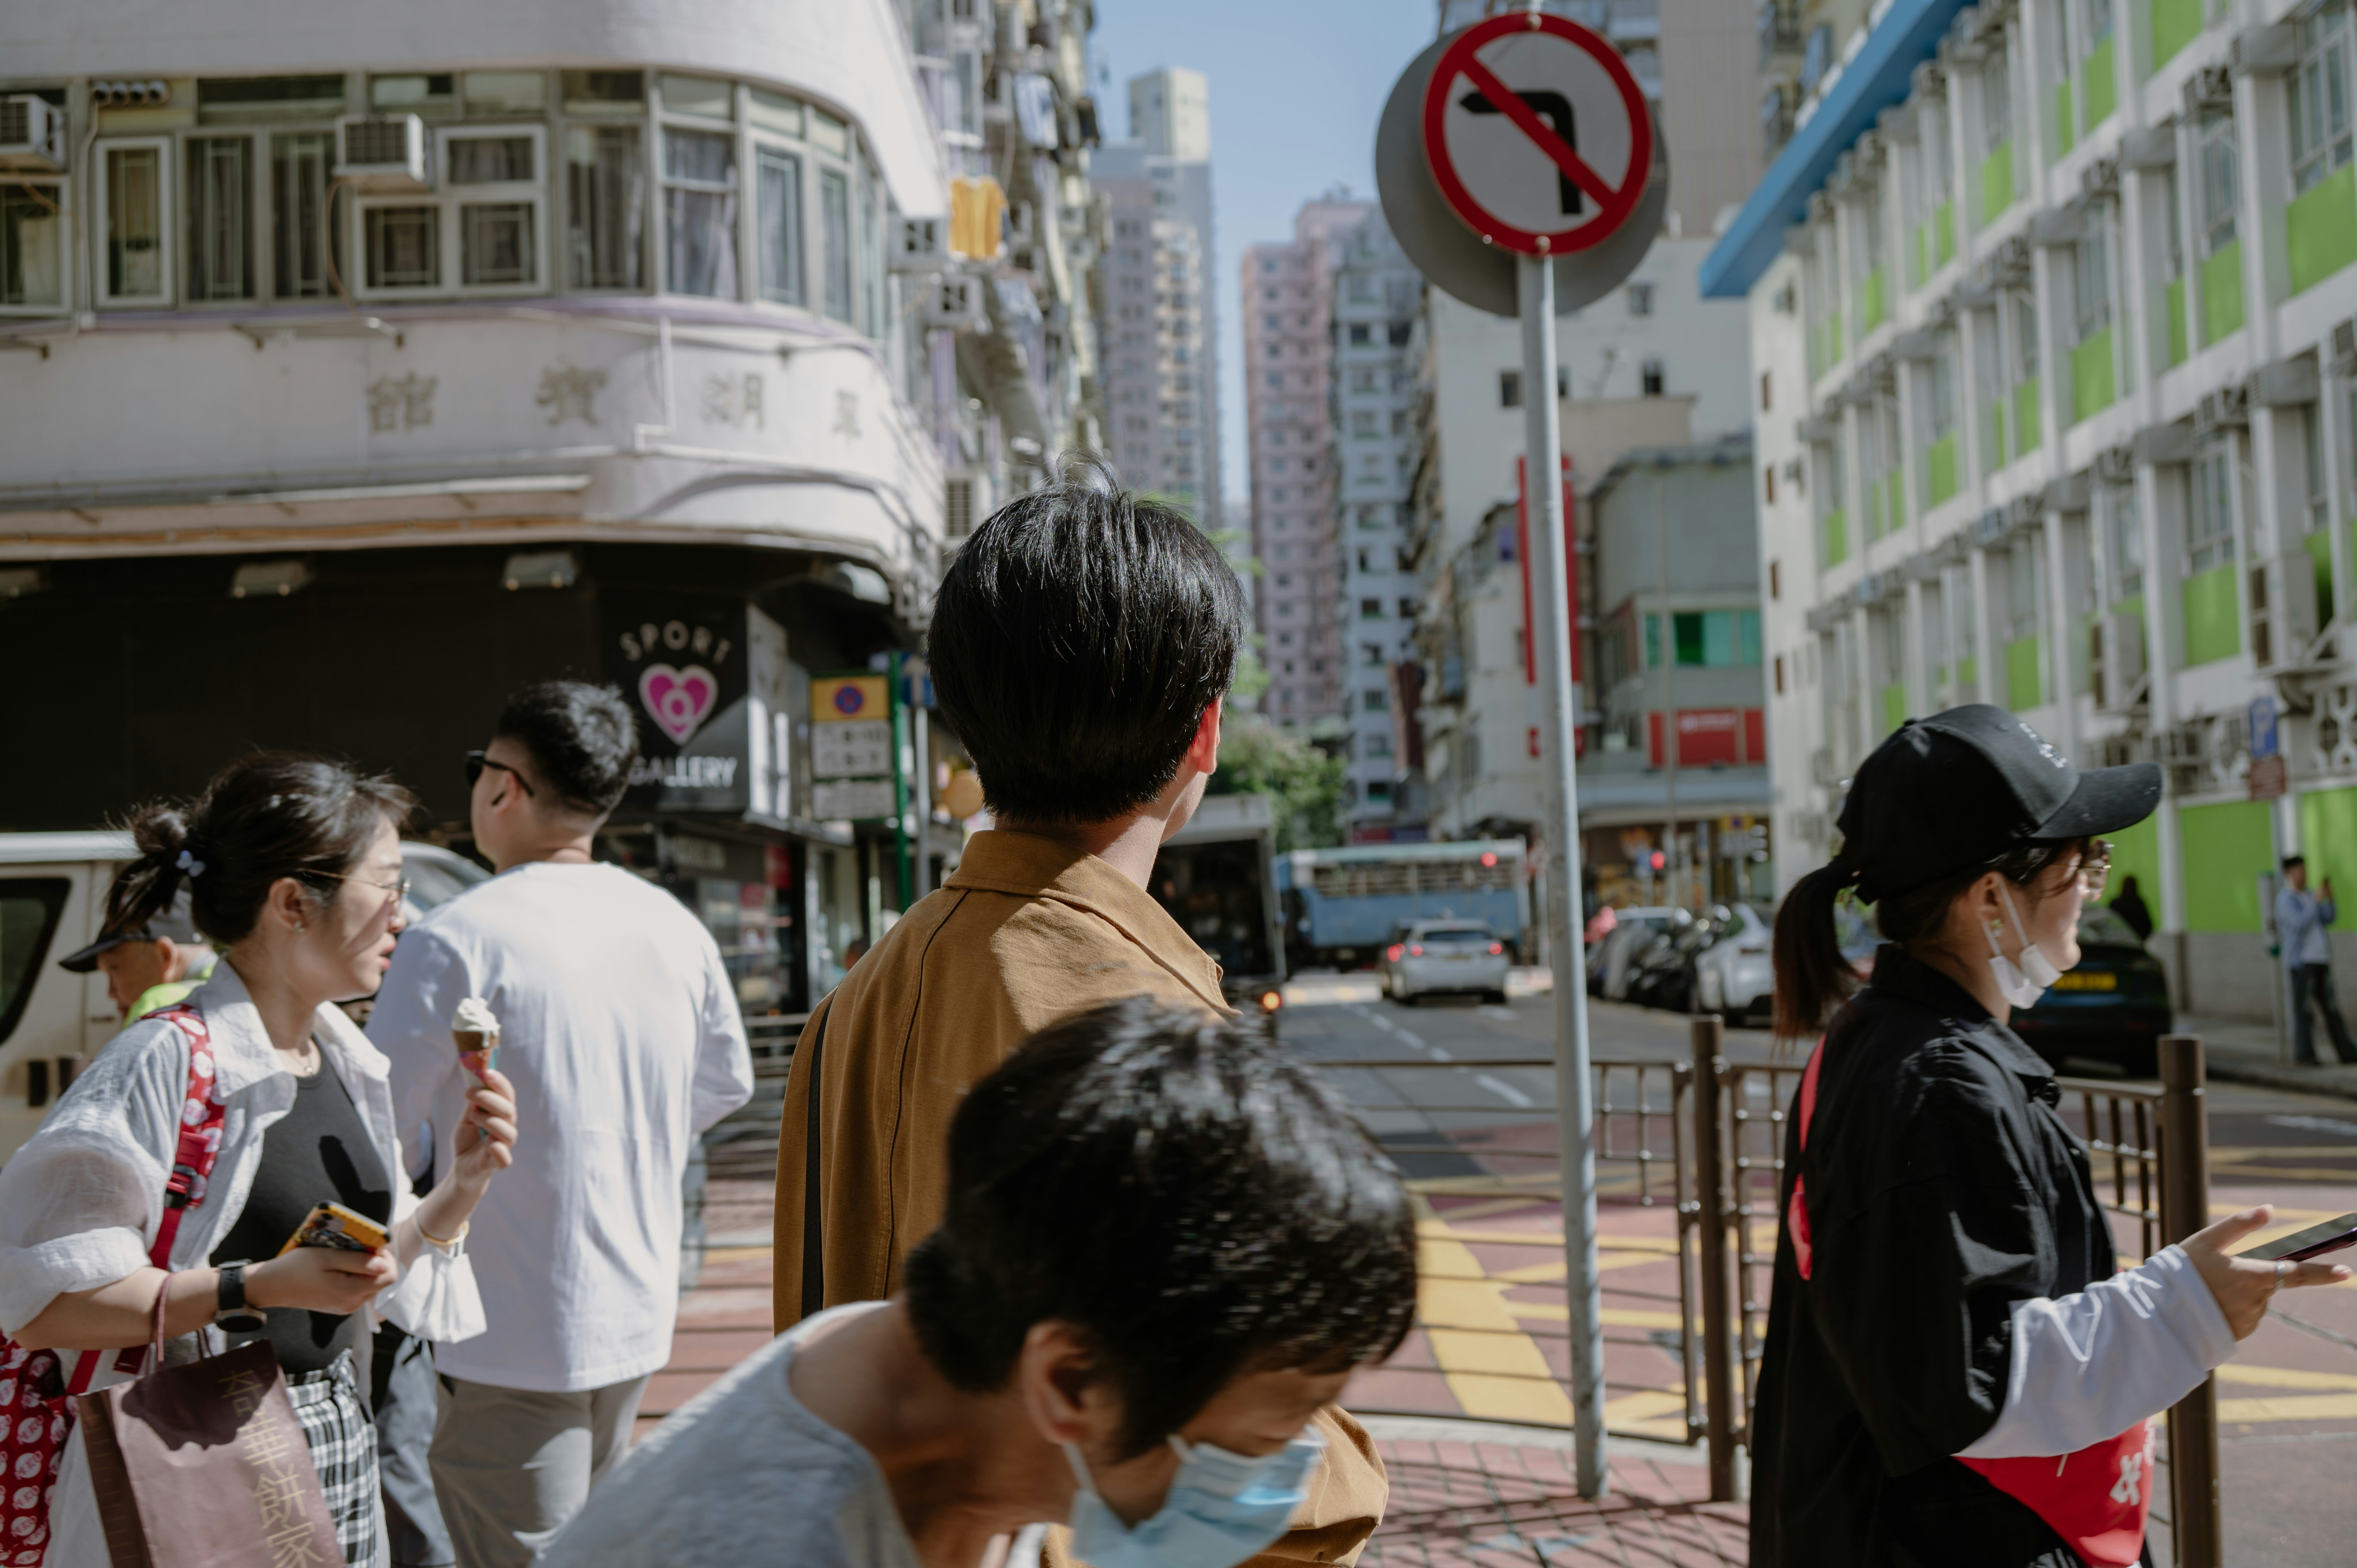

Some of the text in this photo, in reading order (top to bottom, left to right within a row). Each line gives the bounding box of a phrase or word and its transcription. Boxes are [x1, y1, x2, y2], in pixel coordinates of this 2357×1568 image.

[619, 620, 733, 664] SPORT
[629, 755, 738, 788] GALLERY
[218, 1369, 325, 1568] 奇華餅家
